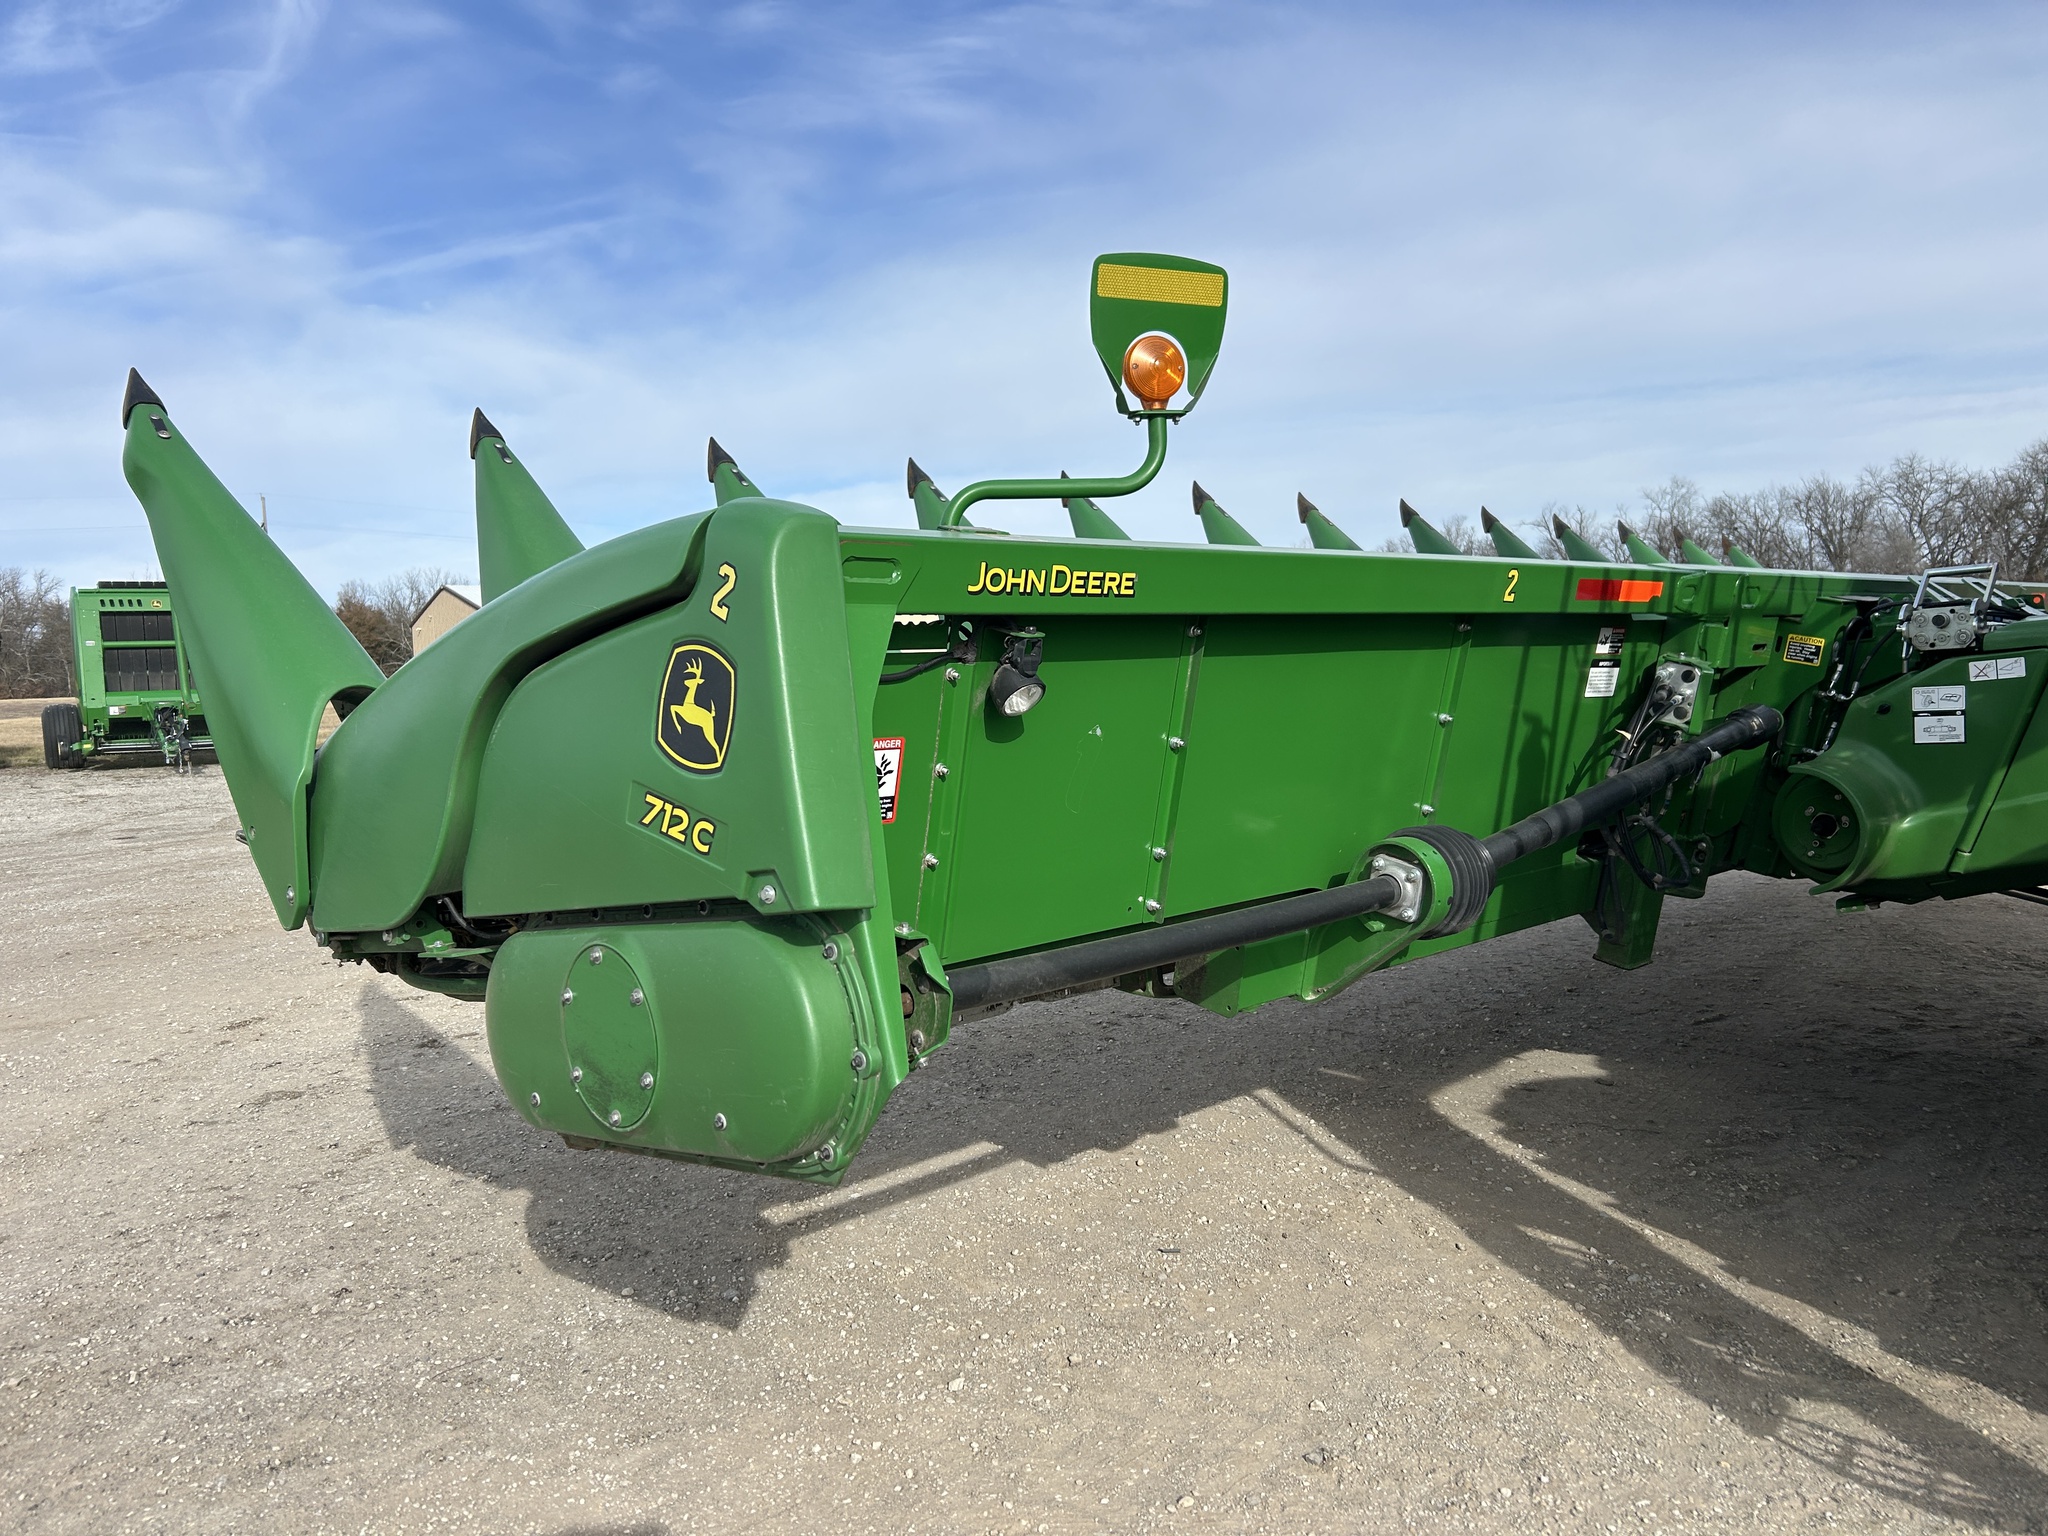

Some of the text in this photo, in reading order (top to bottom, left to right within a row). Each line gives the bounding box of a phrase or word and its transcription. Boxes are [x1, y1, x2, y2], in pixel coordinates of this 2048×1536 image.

[710, 562, 737, 623] 2
[967, 561, 1136, 598] JOHN DEERE
[1503, 568, 1519, 603] 2
[1794, 636, 1823, 645] CAUTION
[873, 739, 902, 749] ANGER
